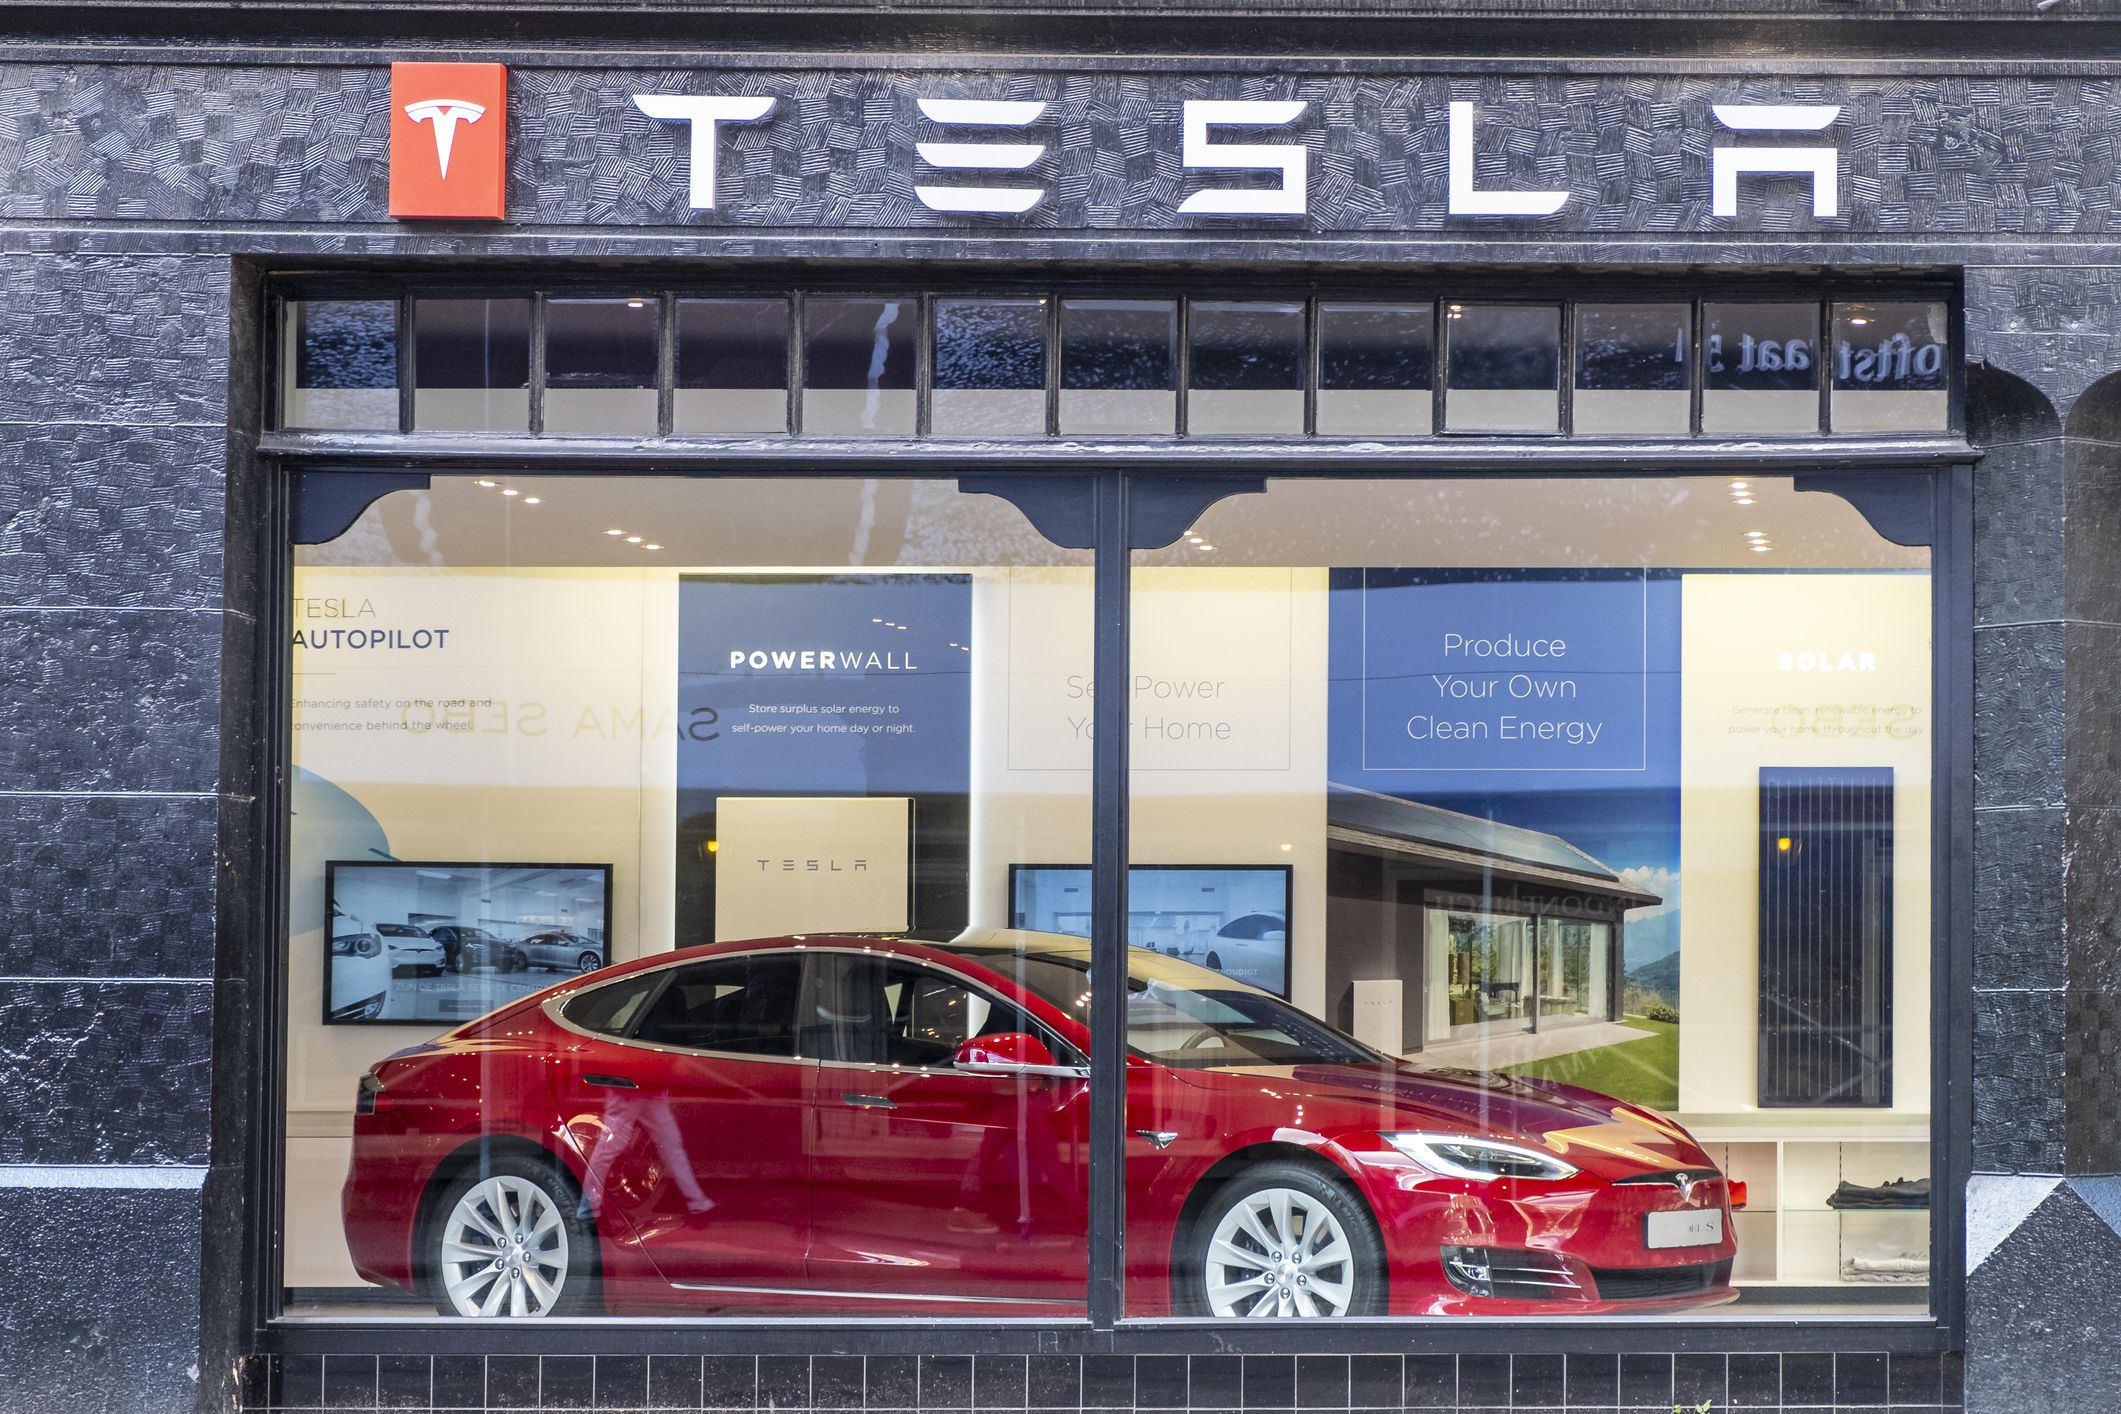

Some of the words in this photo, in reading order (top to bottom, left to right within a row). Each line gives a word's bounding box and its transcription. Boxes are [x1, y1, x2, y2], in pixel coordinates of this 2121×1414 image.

[633, 94, 1842, 218] TESLA
[293, 598, 377, 618] TESLA
[291, 629, 450, 649] AUTOPILOT
[1444, 633, 1567, 657] Produce
[730, 650, 918, 670] POWERWALL
[1776, 651, 1877, 672] SOLAR
[1135, 675, 1226, 699] Power
[1432, 674, 1499, 698] Your
[1508, 674, 1577, 698] Own
[355, 698, 391, 710] safety
[395, 700, 410, 708] on
[414, 698, 433, 708] the
[438, 698, 465, 708] road
[469, 698, 492, 708] and
[749, 703, 777, 714] Store
[780, 703, 818, 716] surplus
[820, 703, 846, 714] solar
[849, 704, 886, 716] energy
[888, 704, 900, 714] to
[1872, 705, 1908, 717] energy
[1910, 705, 1922, 715] to
[366, 721, 408, 731] behind
[412, 721, 432, 730] the
[732, 723, 787, 734] self-power
[790, 725, 814, 735] your
[817, 723, 848, 733] home
[850, 723, 870, 735] day
[872, 725, 884, 733] or
[1144, 716, 1231, 740] Home
[1407, 715, 1489, 740] Clean
[1500, 715, 1603, 745] Energy
[1728, 725, 1761, 737] power
[1764, 726, 1787, 737] your
[1790, 724, 1820, 734] home
[1823, 724, 1883, 736] throughout
[1885, 724, 1902, 734] the
[757, 859, 867, 871] TESLA
